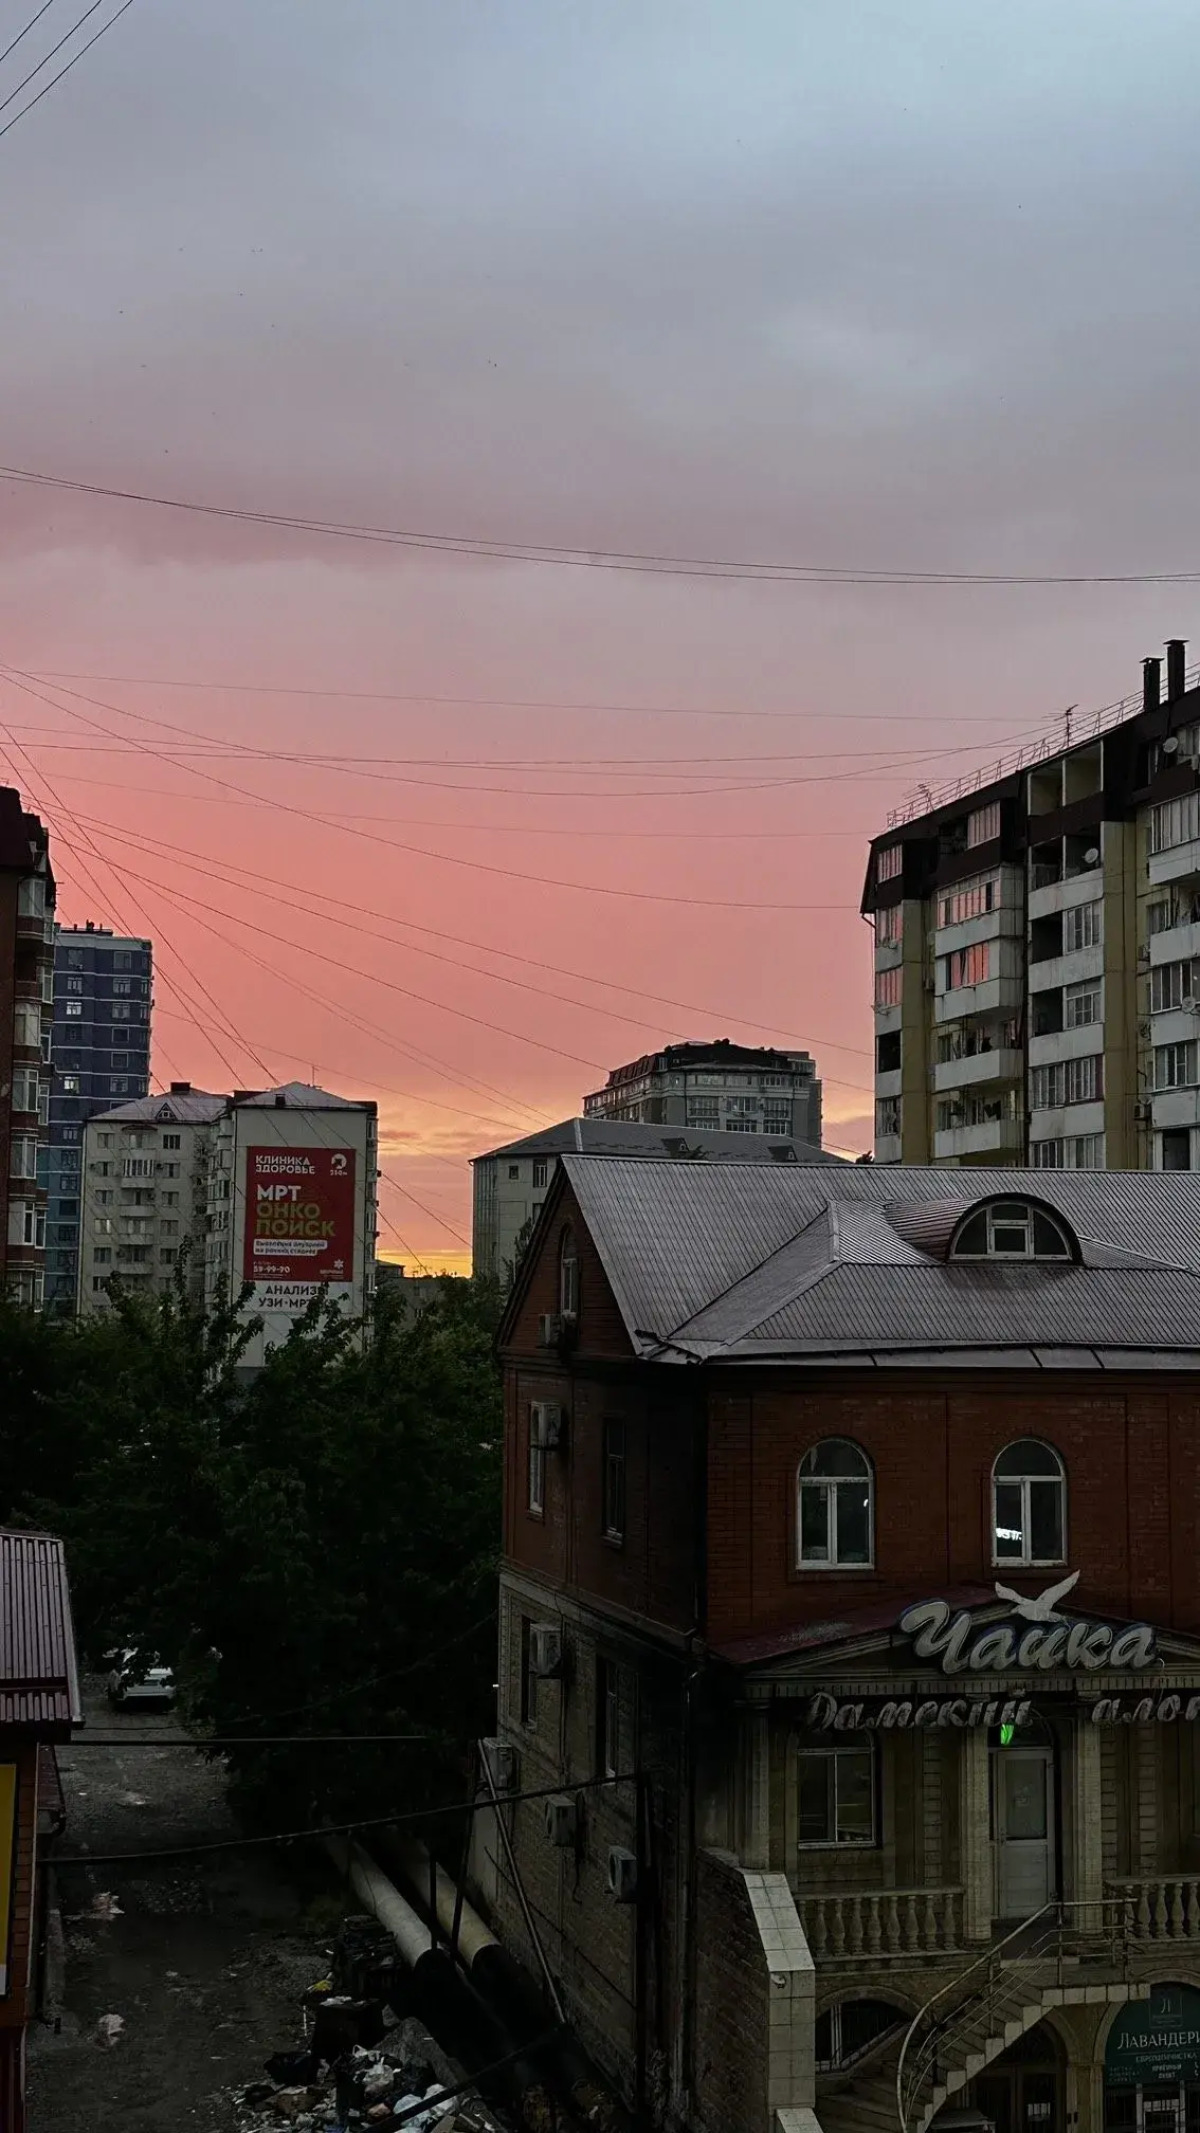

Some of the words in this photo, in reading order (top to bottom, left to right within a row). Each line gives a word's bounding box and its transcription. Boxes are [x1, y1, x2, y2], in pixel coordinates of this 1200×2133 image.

[255, 1155, 311, 1166] КЛИНИКА
[255, 1165, 316, 1175] ЗДОРОВЬЕ
[257, 1184, 302, 1201] МРТ
[256, 1202, 320, 1219] ОНКО
[255, 1219, 336, 1237] ПОИСК
[258, 1297, 282, 1308] УЗИ
